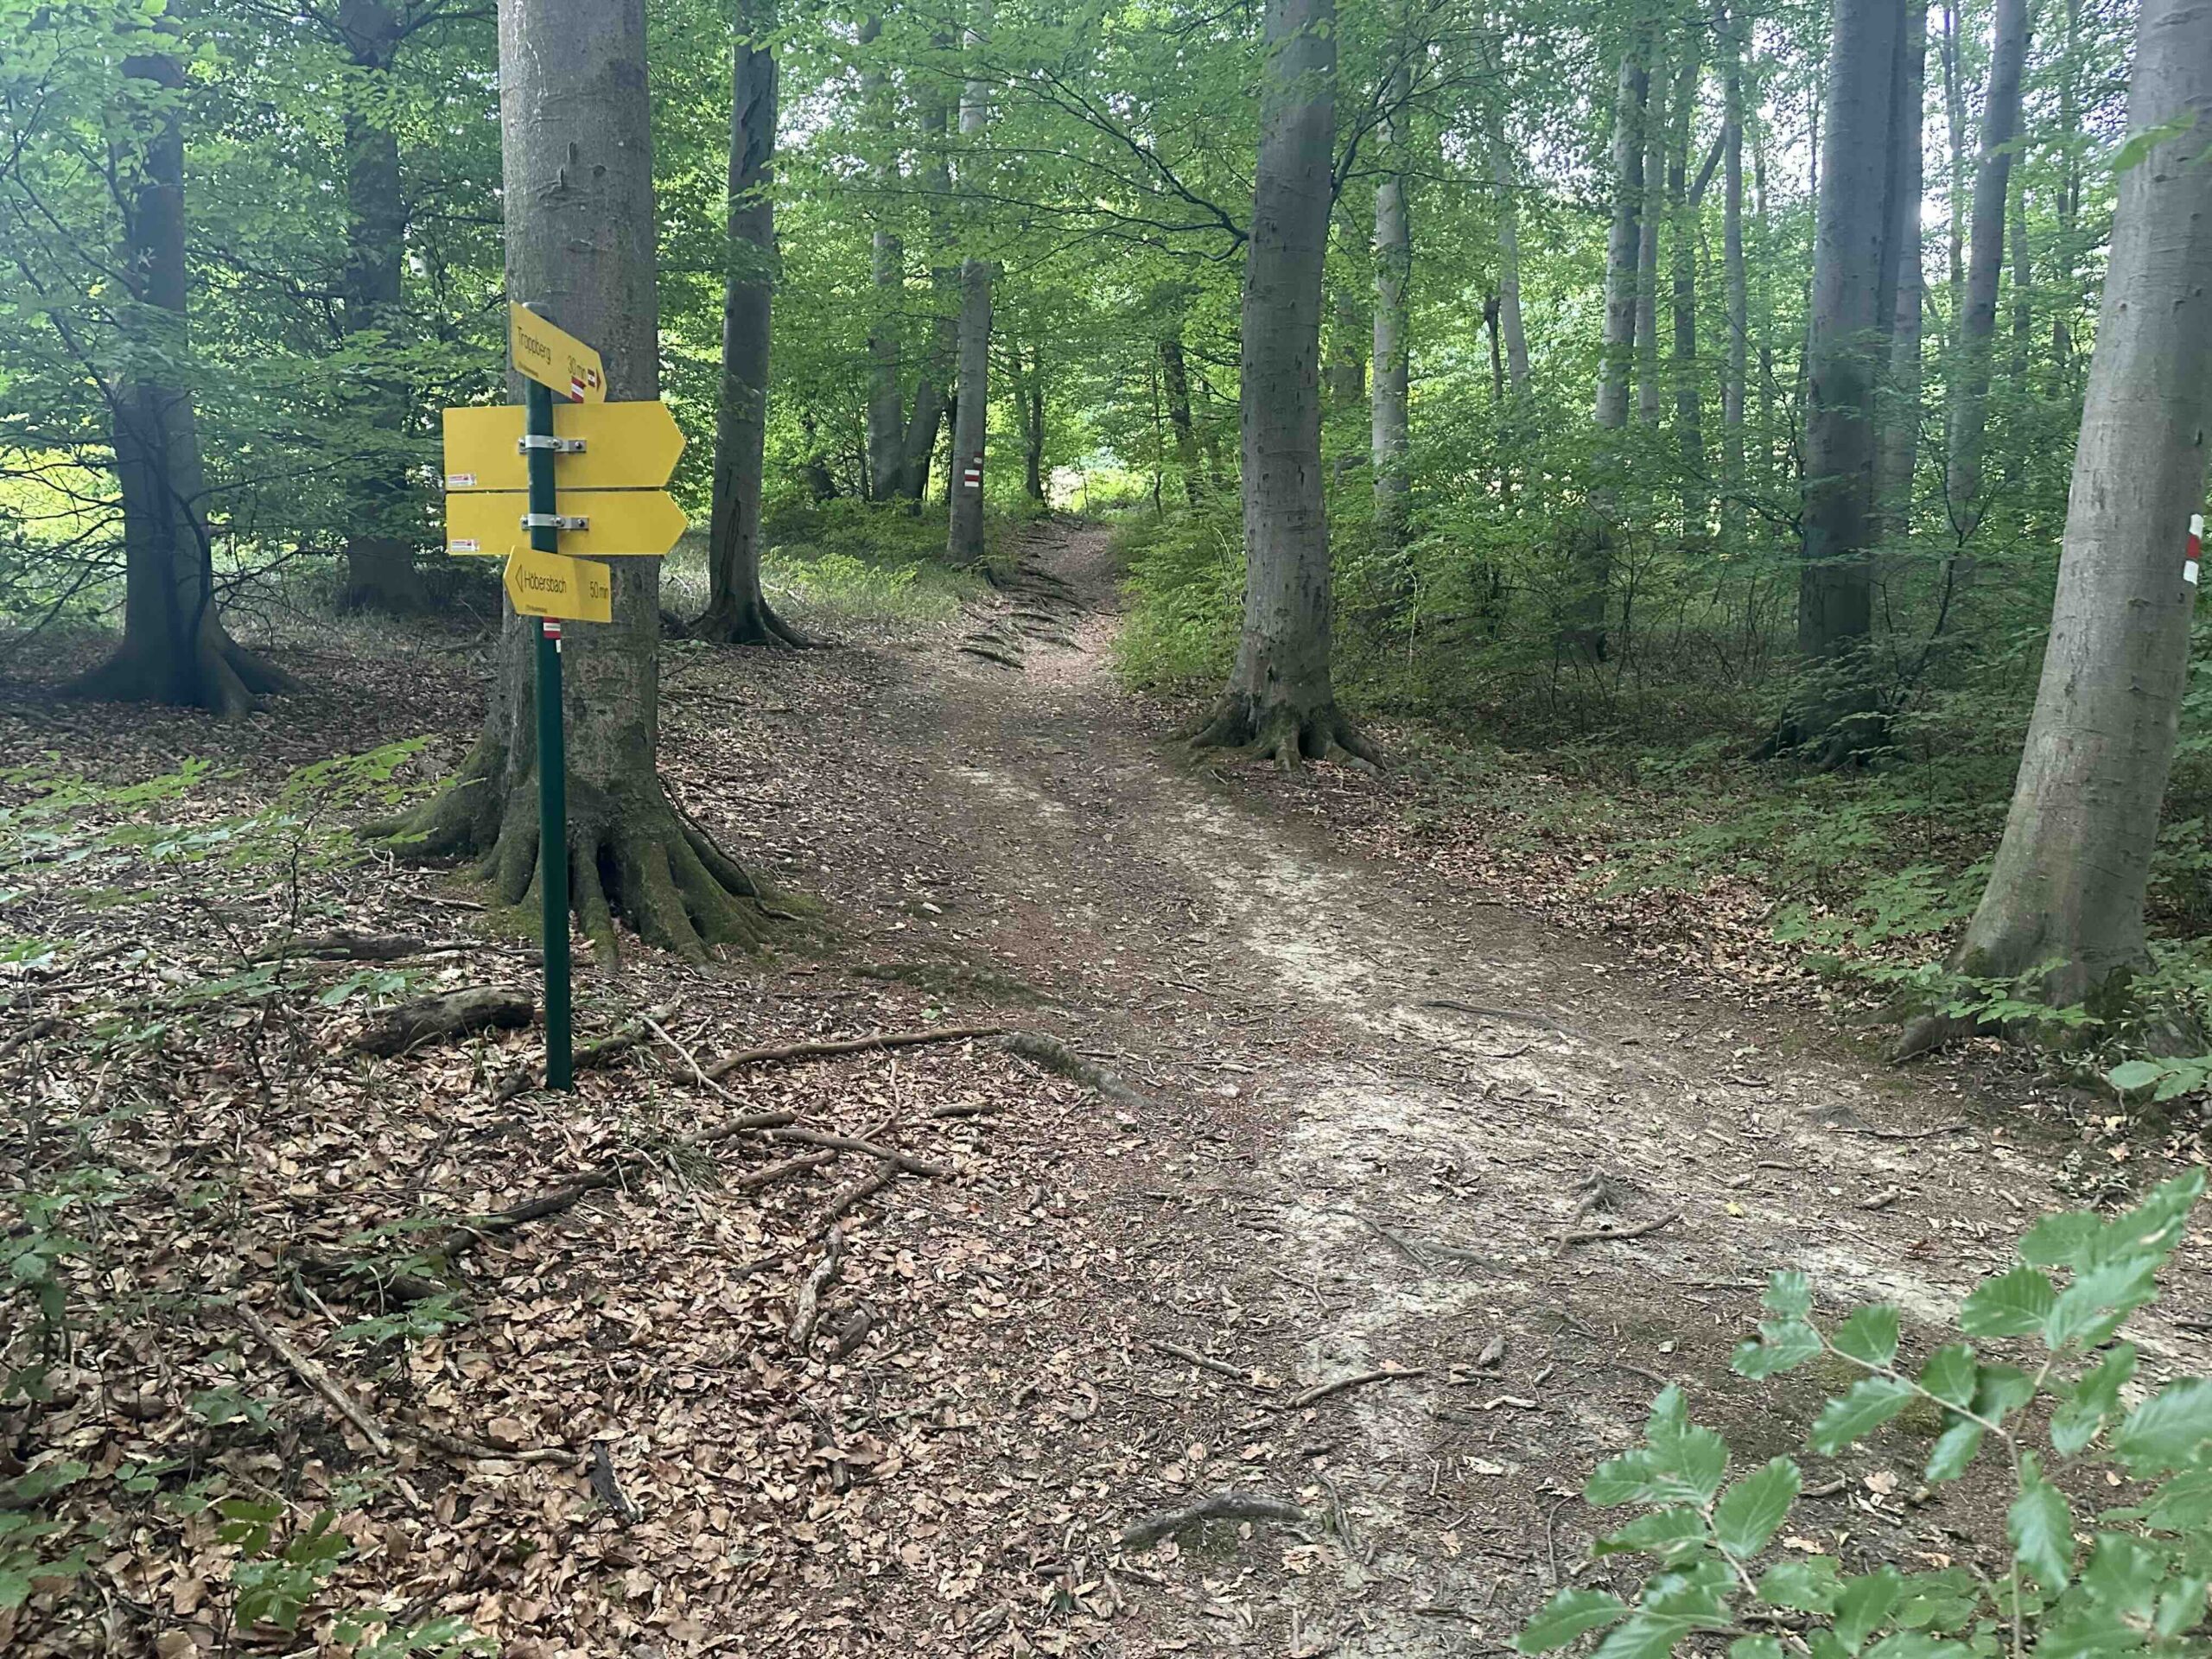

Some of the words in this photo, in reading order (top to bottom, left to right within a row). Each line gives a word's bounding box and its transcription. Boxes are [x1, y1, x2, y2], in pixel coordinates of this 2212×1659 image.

[517, 326, 551, 365] Troppberg
[567, 355, 576, 376] 30
[524, 570, 567, 594] Höbersbach
[589, 581, 599, 599] 50
